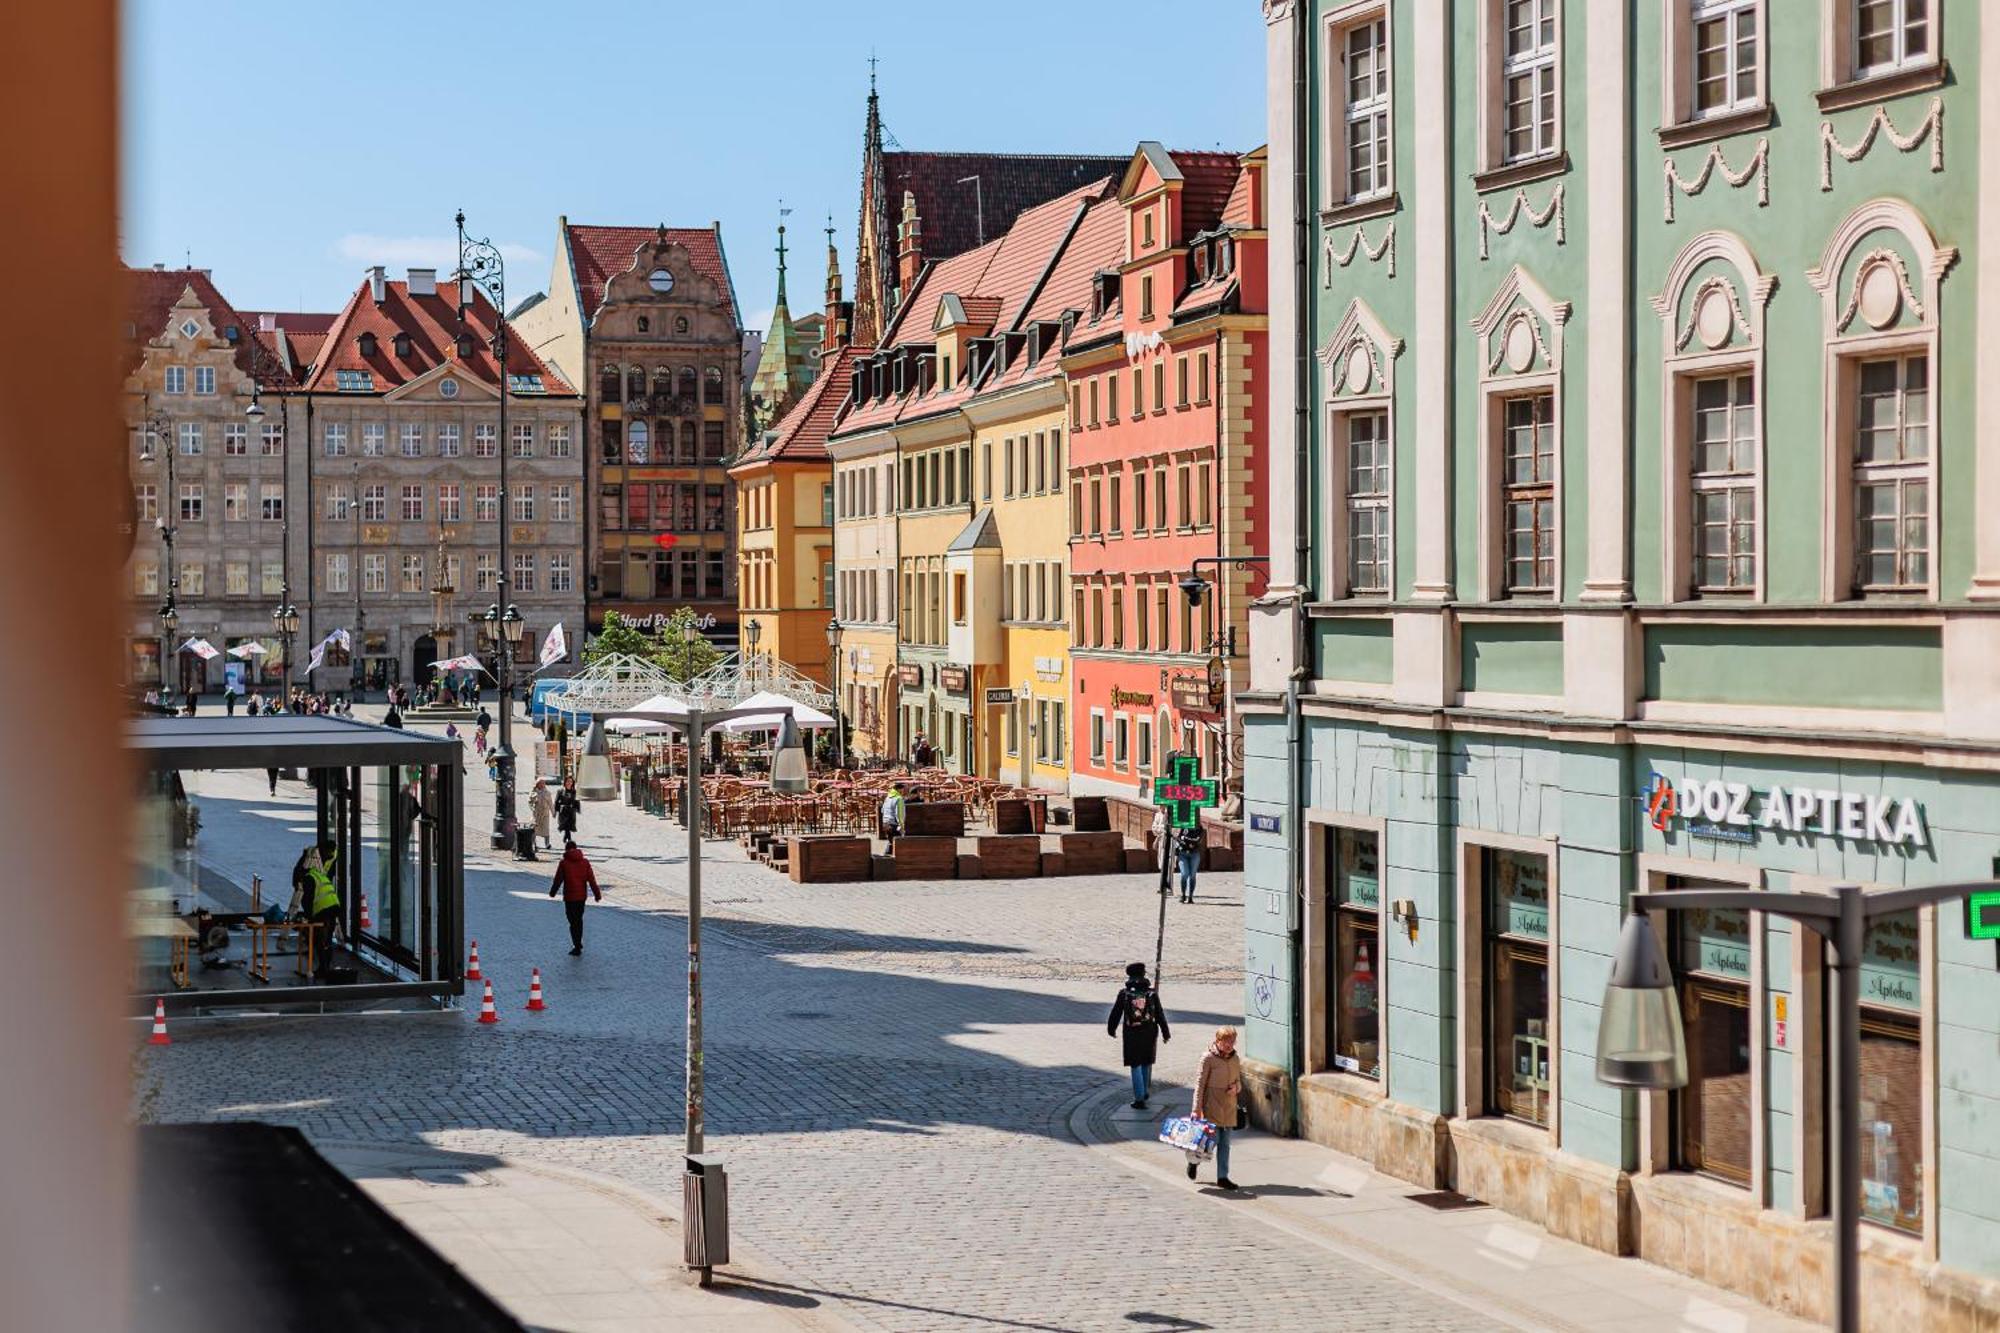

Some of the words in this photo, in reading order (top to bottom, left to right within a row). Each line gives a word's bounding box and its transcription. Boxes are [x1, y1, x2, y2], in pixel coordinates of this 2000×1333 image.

[621, 613, 652, 629] Hard
[689, 612, 717, 630] afe
[1165, 785, 1204, 800] 11:53
[1681, 778, 1752, 825] DOZ
[1763, 784, 1928, 846] APTEKA
[1708, 949, 1747, 972] Apteka
[1868, 976, 1914, 1001] Apteka
